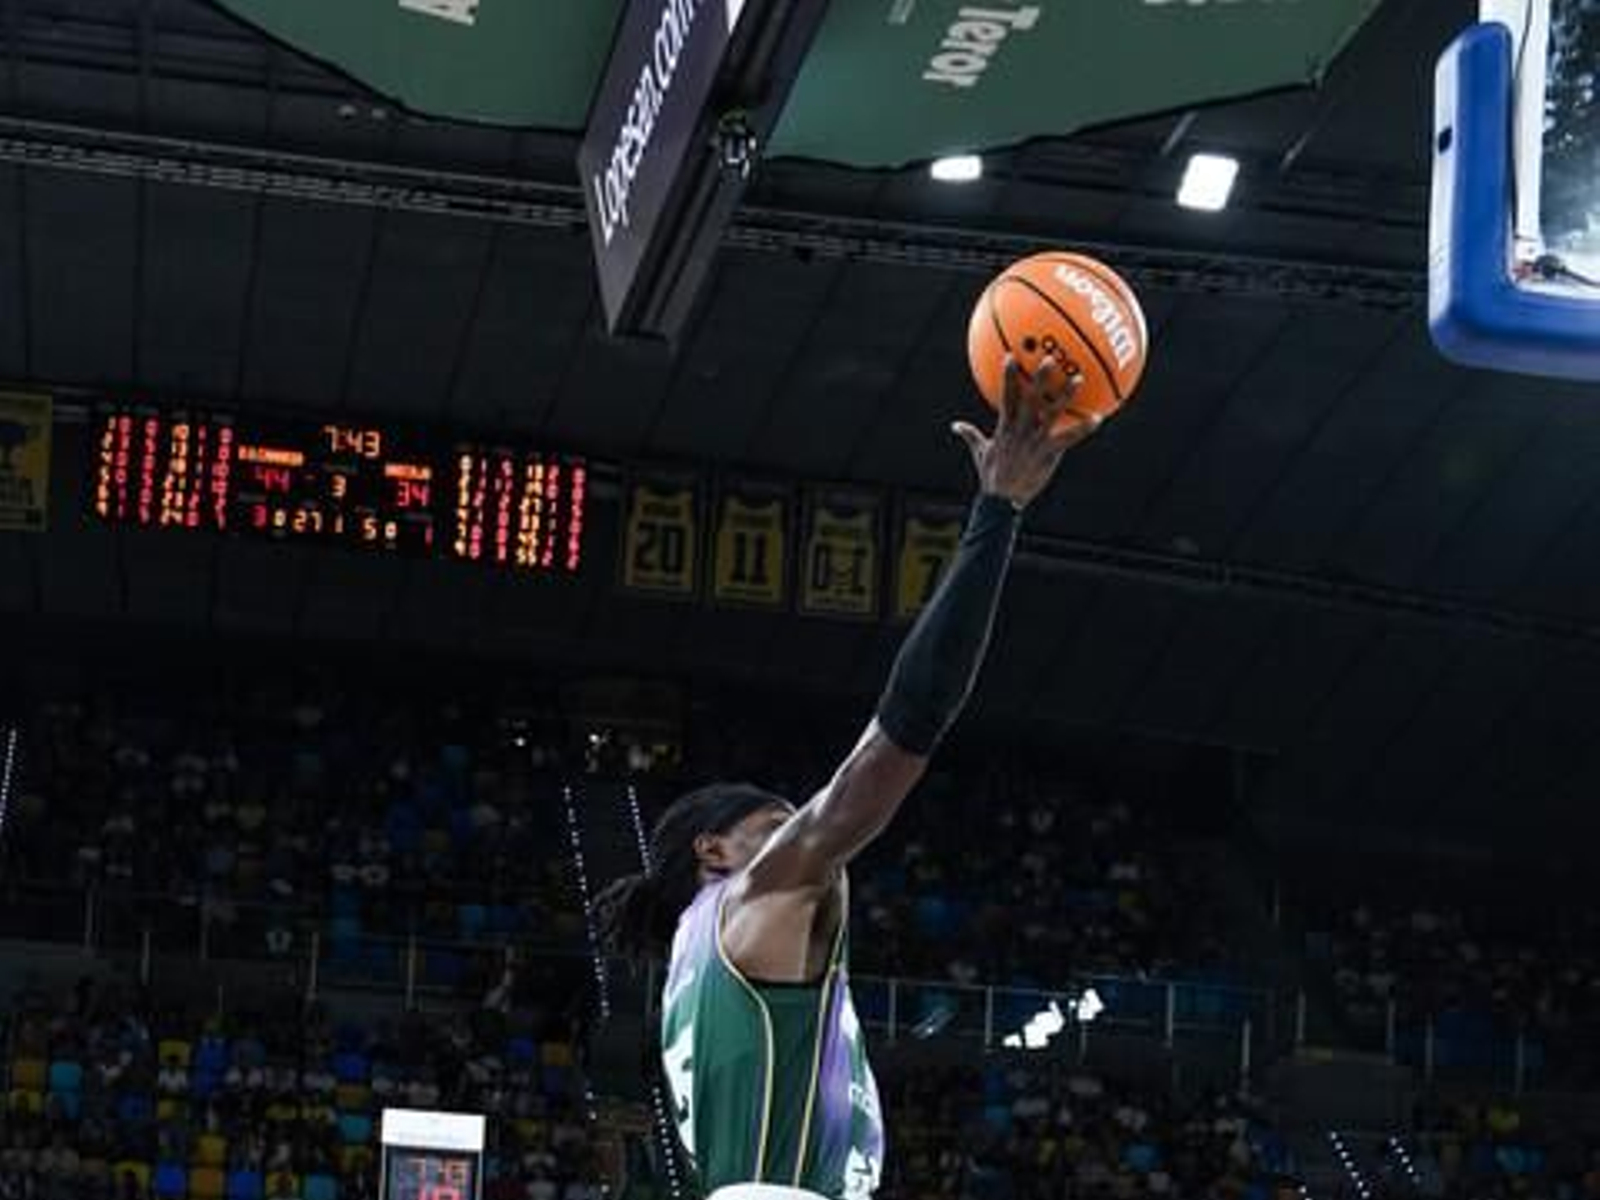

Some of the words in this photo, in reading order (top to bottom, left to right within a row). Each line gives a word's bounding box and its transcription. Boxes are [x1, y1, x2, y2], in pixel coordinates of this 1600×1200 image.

[922, 6, 1040, 87] Teror
[324, 424, 380, 459] 7:43
[256, 465, 290, 491] 44
[331, 475, 347, 497] 3
[397, 481, 431, 507] 34
[635, 521, 685, 574] 20
[730, 531, 769, 585] 11
